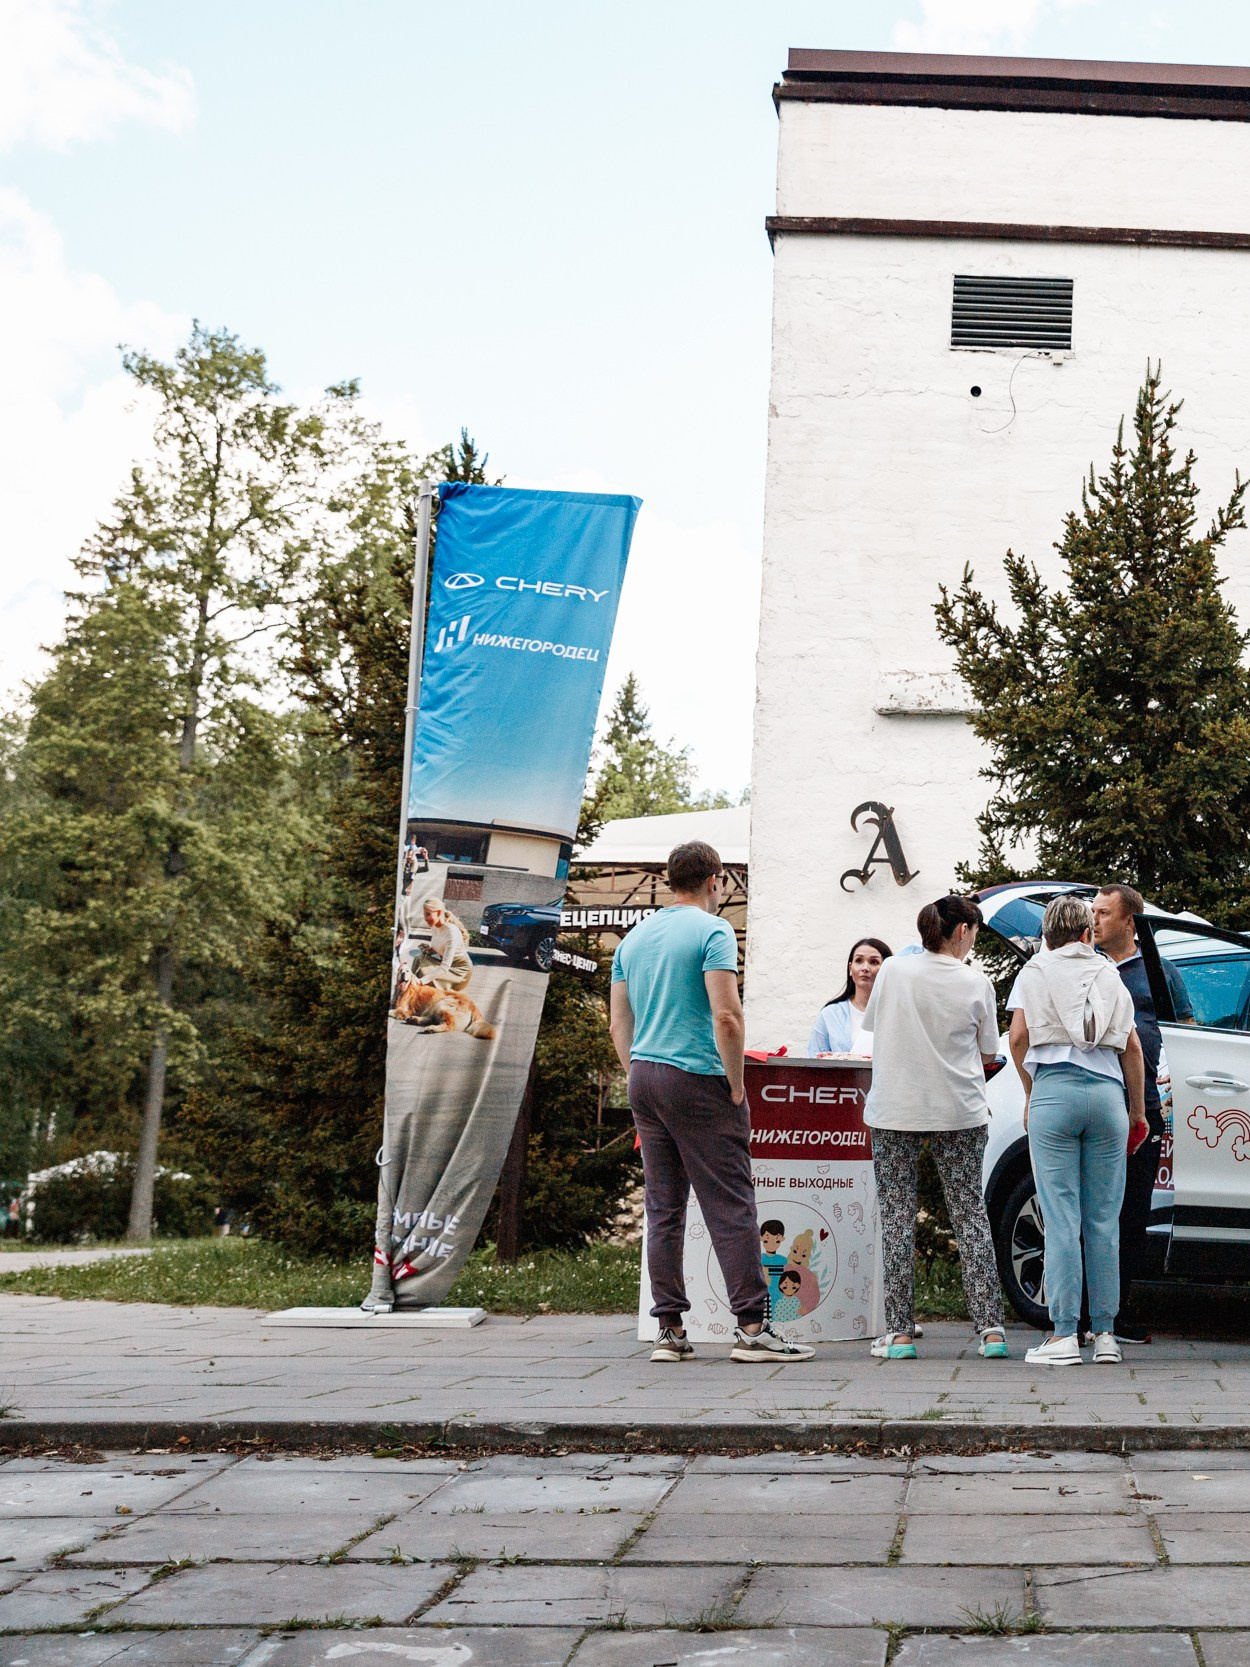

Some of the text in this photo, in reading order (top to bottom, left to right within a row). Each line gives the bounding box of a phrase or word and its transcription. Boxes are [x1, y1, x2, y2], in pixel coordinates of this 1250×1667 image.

[495, 576, 609, 602] CHERY
[472, 633, 600, 662] НИЖЕГОРОДЕЦ
[560, 909, 656, 929] ЕЦЕПЦИЯ
[750, 1129, 866, 1147] НИЖЕГОРОДЕЦ
[790, 1178, 854, 1190] ВЫХОДНЫЕ
